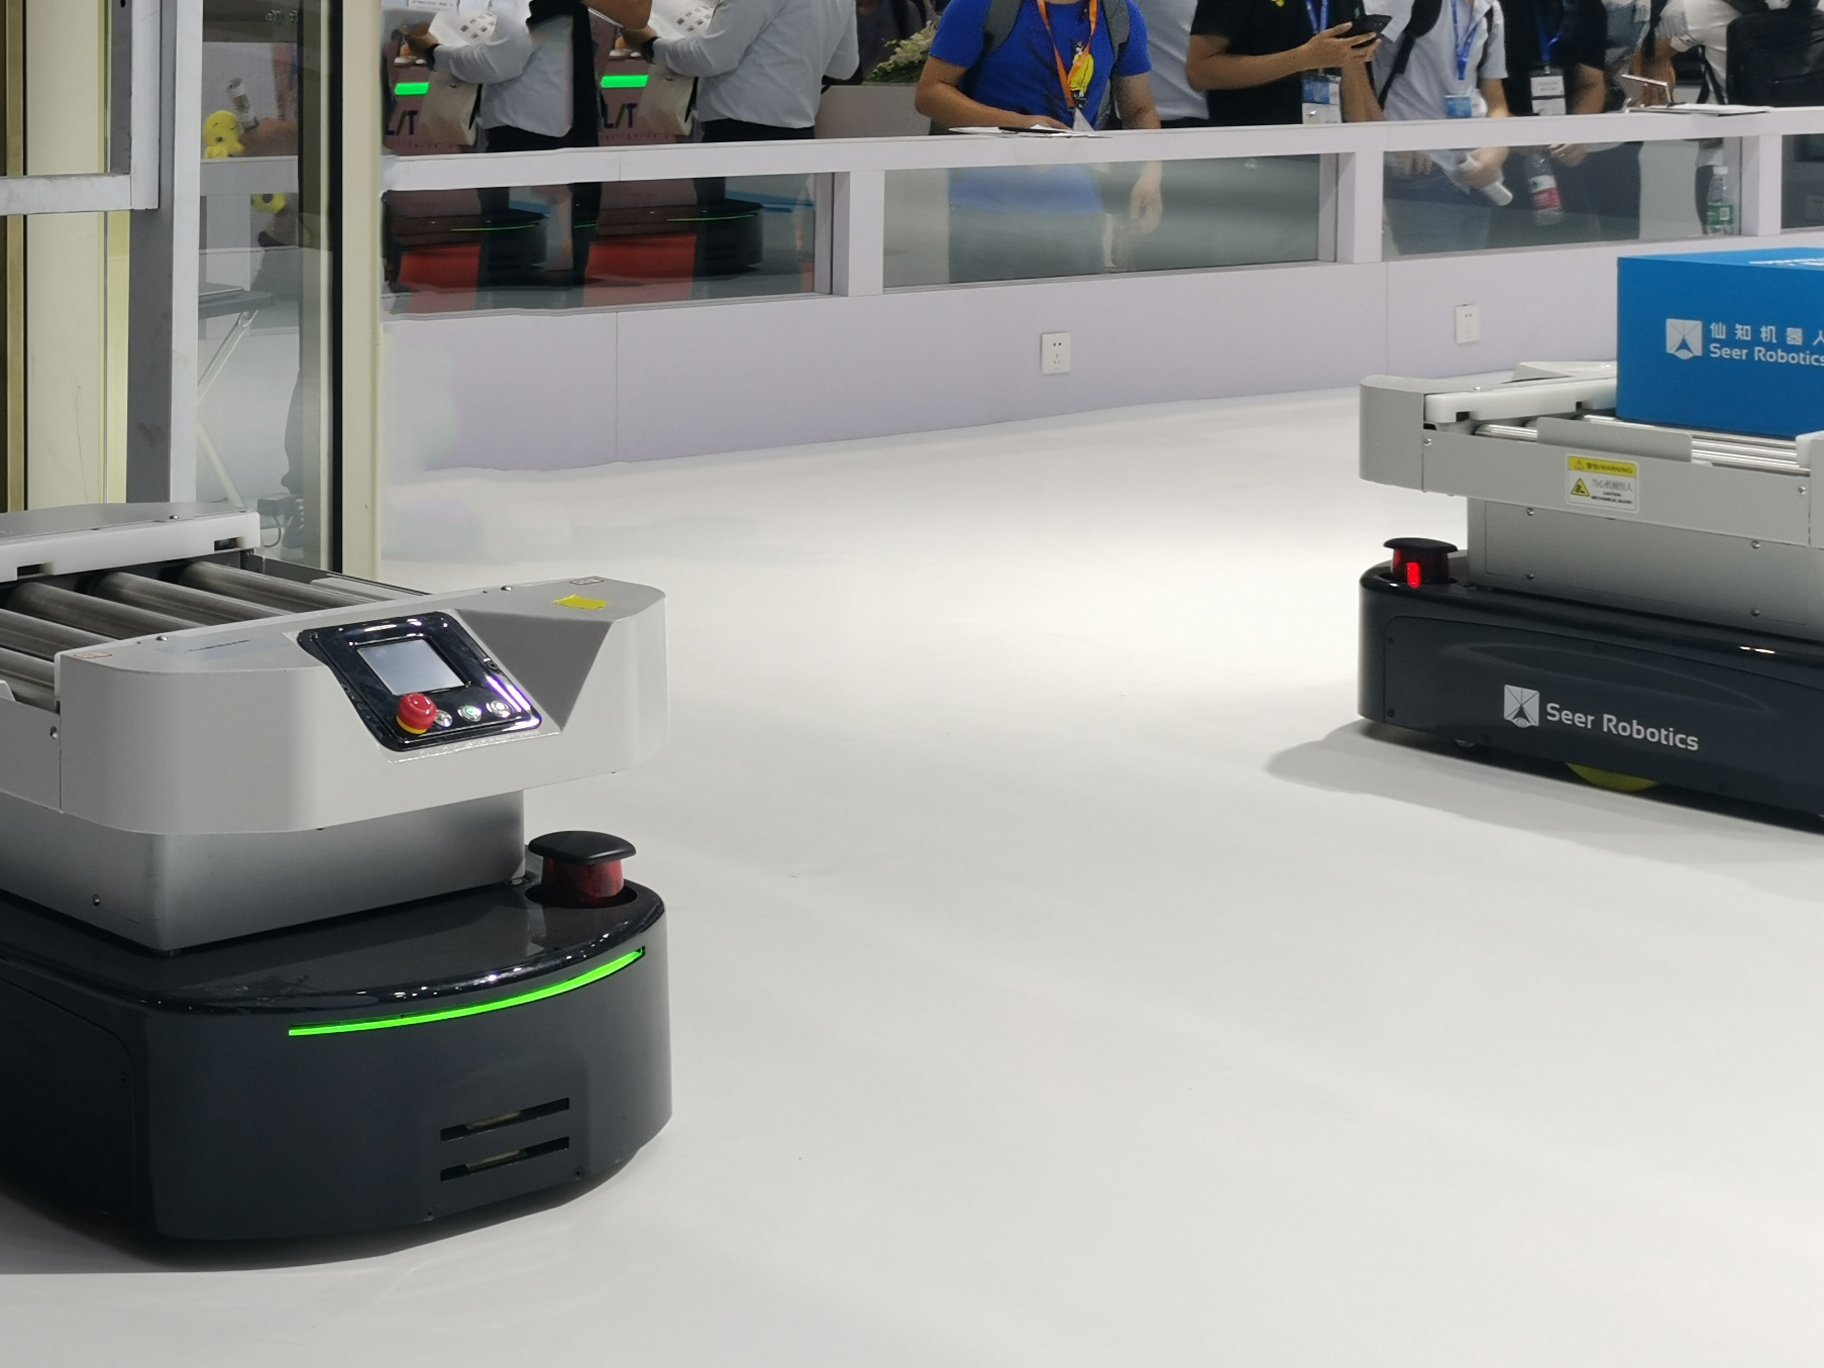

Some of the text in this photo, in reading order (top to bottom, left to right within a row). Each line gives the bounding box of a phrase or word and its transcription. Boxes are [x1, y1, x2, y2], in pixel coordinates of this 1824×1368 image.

[1709, 322, 1824, 346] 仙知机器人
[1709, 343, 1824, 367] Seer Robotics
[1546, 702, 1700, 751] Seer Robotics
